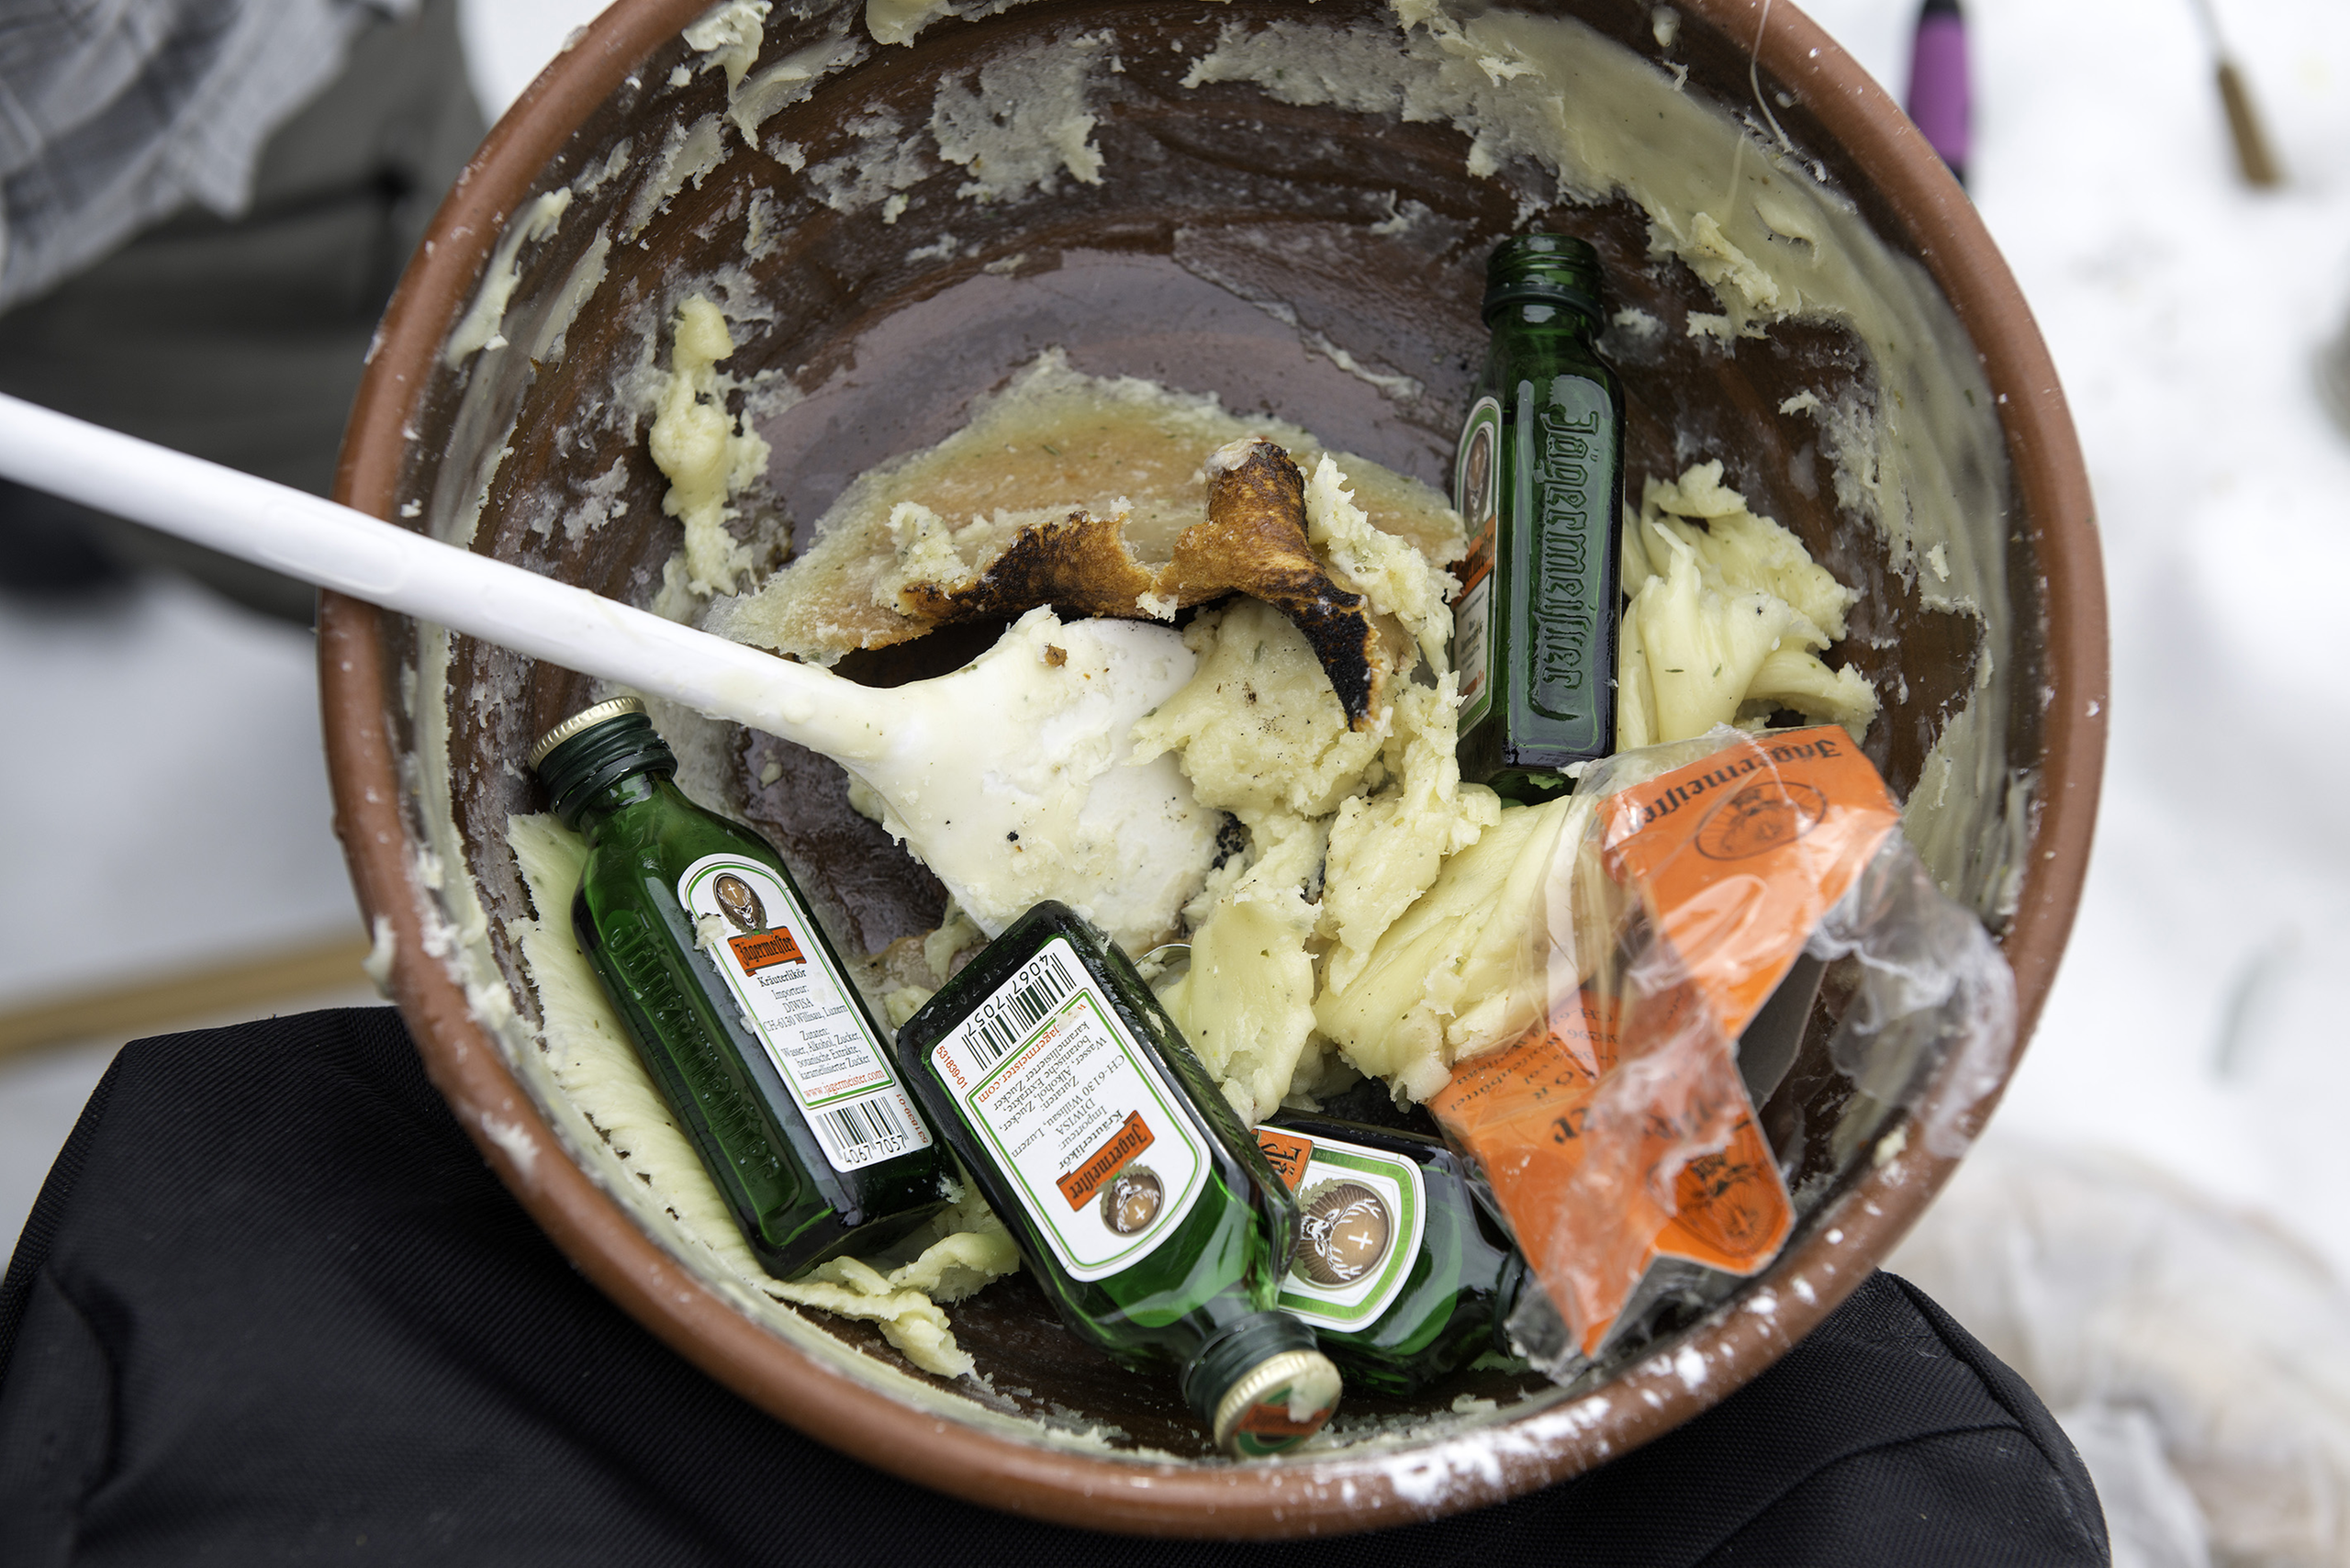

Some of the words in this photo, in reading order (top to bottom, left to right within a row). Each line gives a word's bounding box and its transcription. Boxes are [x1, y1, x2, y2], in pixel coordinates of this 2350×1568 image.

[735, 935, 796, 967] Jägermeister
[757, 969, 807, 988] Kräuterlikör
[1012, 954, 1049, 995] 4067
[771, 984, 810, 1002] Importeur:
[782, 997, 814, 1014] DIWISA
[763, 1015, 796, 1033] CH-6130
[796, 1007, 826, 1024] Willisau,
[822, 1003, 848, 1018] Luzern
[967, 995, 1006, 1036] 7057
[780, 1043, 810, 1058] Wasser,
[808, 1037, 837, 1053] Alkohol,
[834, 1031, 863, 1046] Zucker,
[800, 1027, 831, 1042] Zutaten:
[1024, 1021, 1091, 1082] karamellisierter
[1070, 1036, 1108, 1066] Wasser,
[796, 1051, 834, 1069] botanische
[834, 1045, 862, 1060] Extrakte,
[845, 1055, 871, 1069] Zucker
[935, 1045, 968, 1090] 531839-01
[978, 1002, 1087, 1103] w.jagermeister.com
[1045, 1035, 1092, 1080] botanische
[1033, 1065, 1073, 1101] Alkohol,
[1081, 1054, 1126, 1096] CH-6130
[993, 1080, 1026, 1112] Zucker
[1002, 1076, 1046, 1113] Extrakte,
[1042, 1075, 1080, 1113] Zutaten:
[1047, 1093, 1085, 1126] Willisau,
[895, 1092, 929, 1145] 531839-01
[999, 1099, 1036, 1132] Zucker,
[1055, 1097, 1096, 1136] DIWISA
[1058, 1105, 1108, 1150] Importeur:
[844, 1145, 873, 1165] 4067
[876, 1135, 907, 1156] 7057
[1011, 1126, 1046, 1159] Luzern
[1058, 1109, 1125, 1170] Kräuterlikör
[1069, 1123, 1147, 1200] Jägermeister
